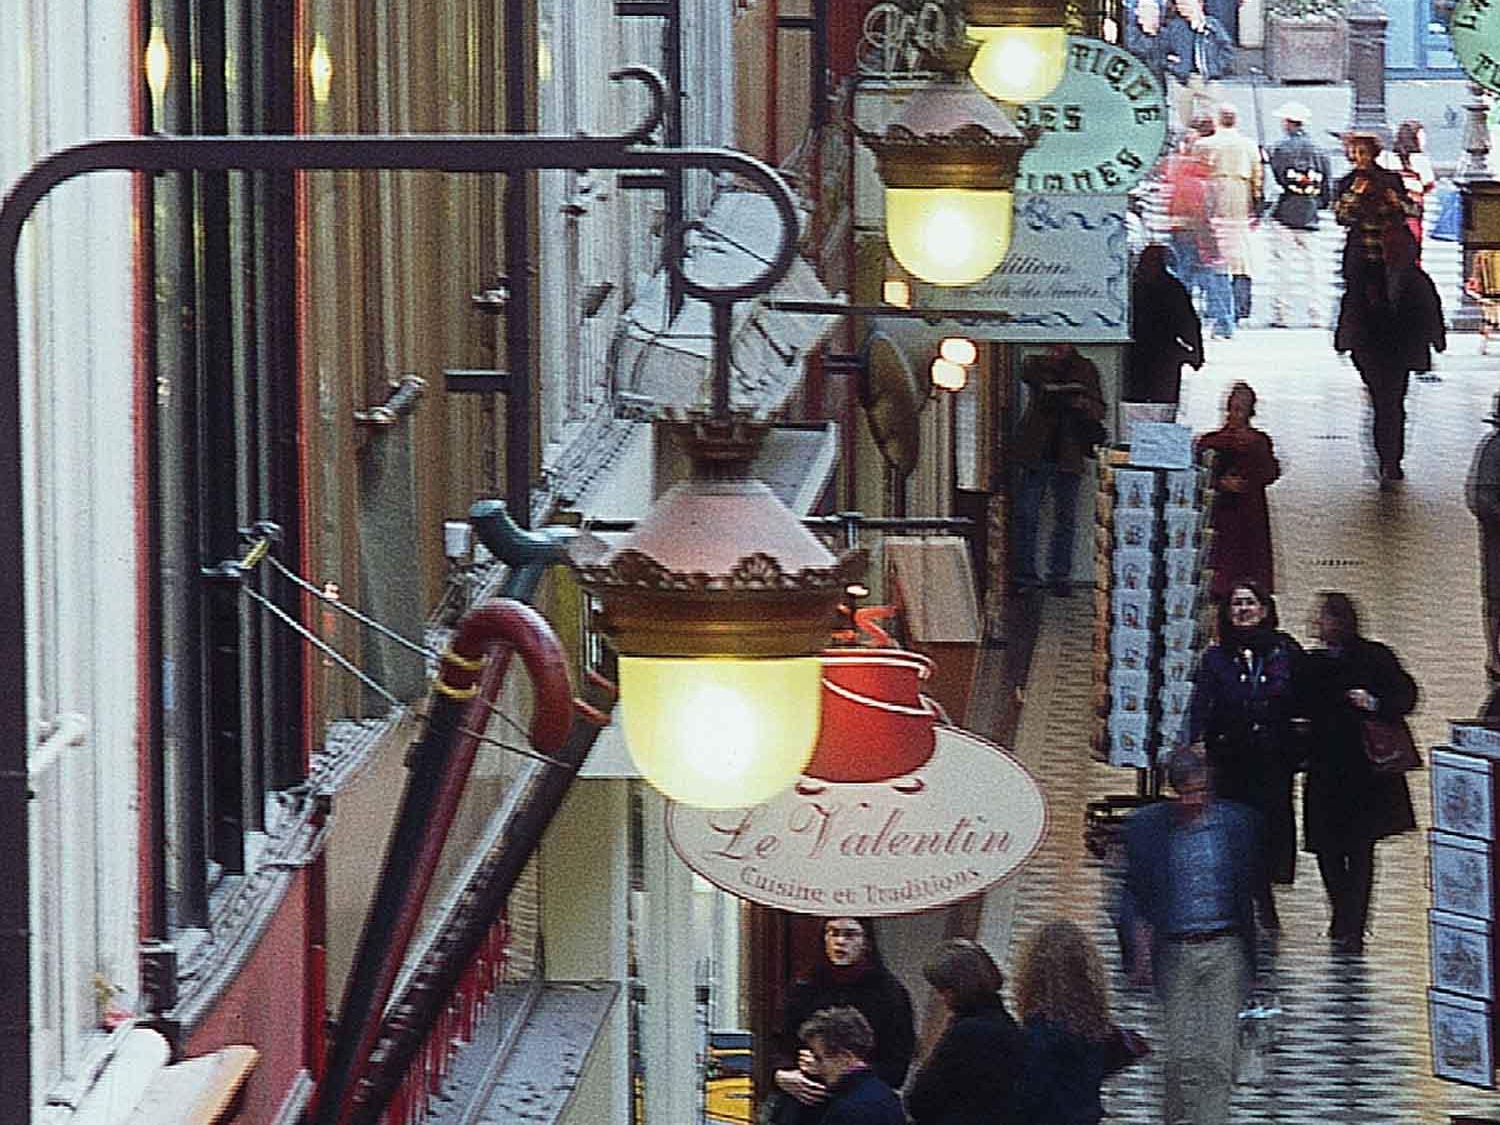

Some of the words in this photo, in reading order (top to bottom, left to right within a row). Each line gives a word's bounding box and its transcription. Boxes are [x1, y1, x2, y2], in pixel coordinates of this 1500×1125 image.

[1070, 43, 1162, 125] TIQUE
[702, 805, 783, 861] Le
[788, 801, 1014, 861] Valentin
[738, 864, 825, 906] Cuisine
[831, 889, 859, 905] et
[862, 868, 981, 905] Traditions
